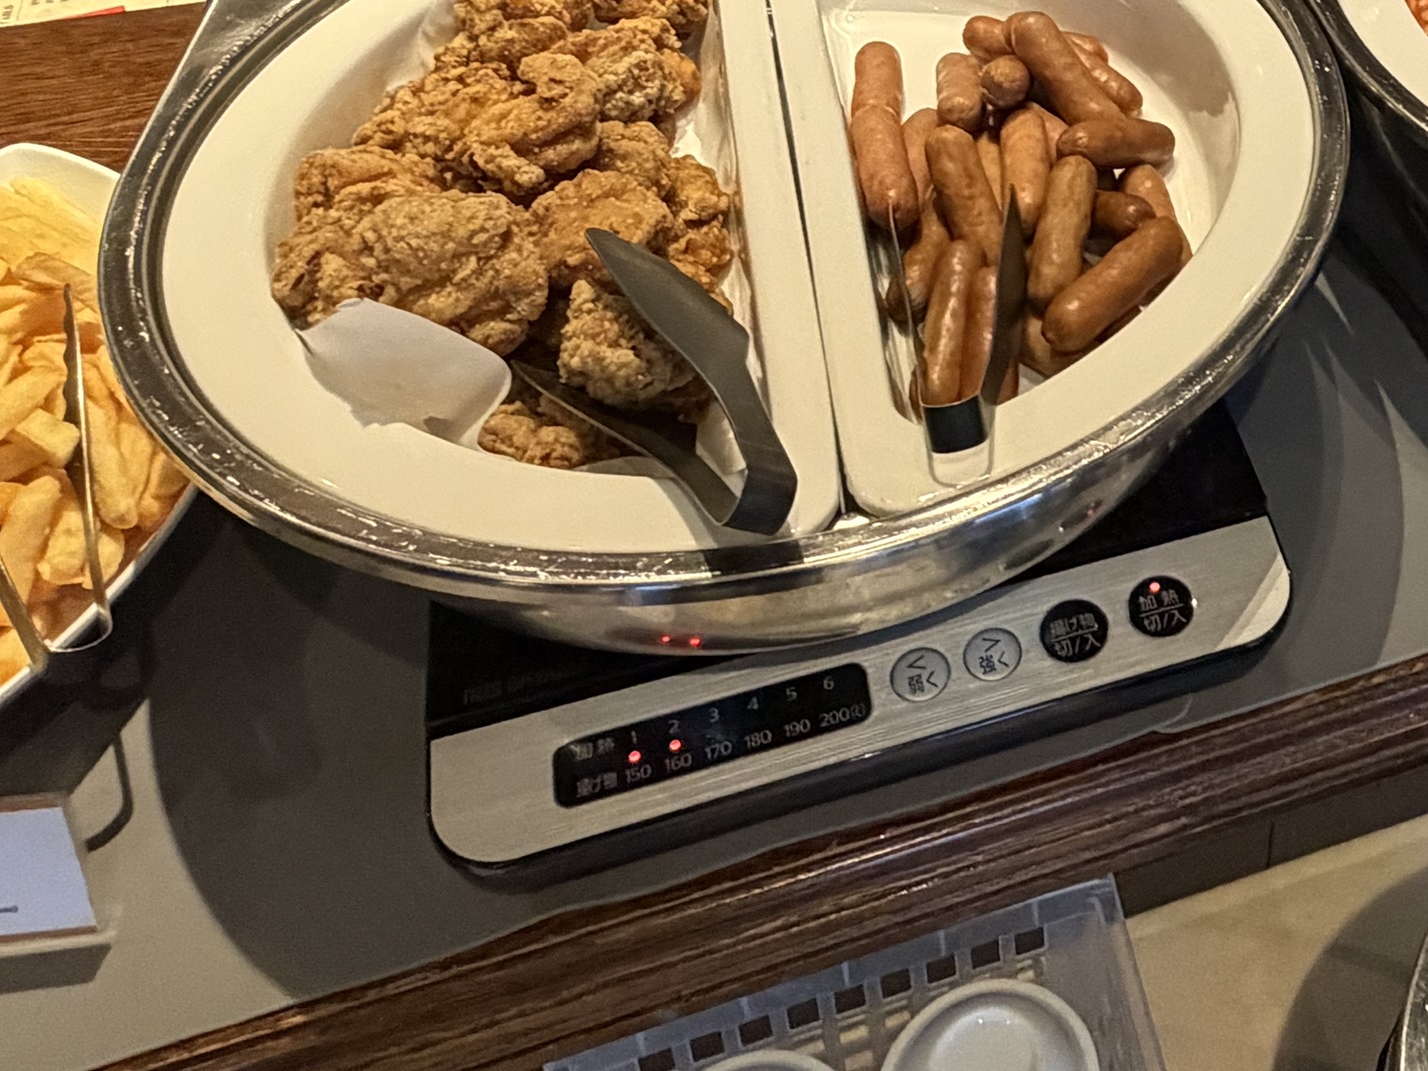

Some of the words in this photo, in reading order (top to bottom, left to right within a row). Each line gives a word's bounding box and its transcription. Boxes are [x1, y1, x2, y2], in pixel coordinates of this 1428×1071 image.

[978, 652, 1010, 675] 強く
[709, 707, 720, 723] 3
[747, 696, 759, 710] 4
[785, 687, 798, 701] 5
[822, 676, 835, 690] 6
[907, 671, 939, 694] 弱く
[624, 763, 652, 784] 150
[663, 754, 693, 772] 160
[704, 740, 733, 759] 170
[743, 729, 773, 748] 180
[783, 718, 811, 737] 190
